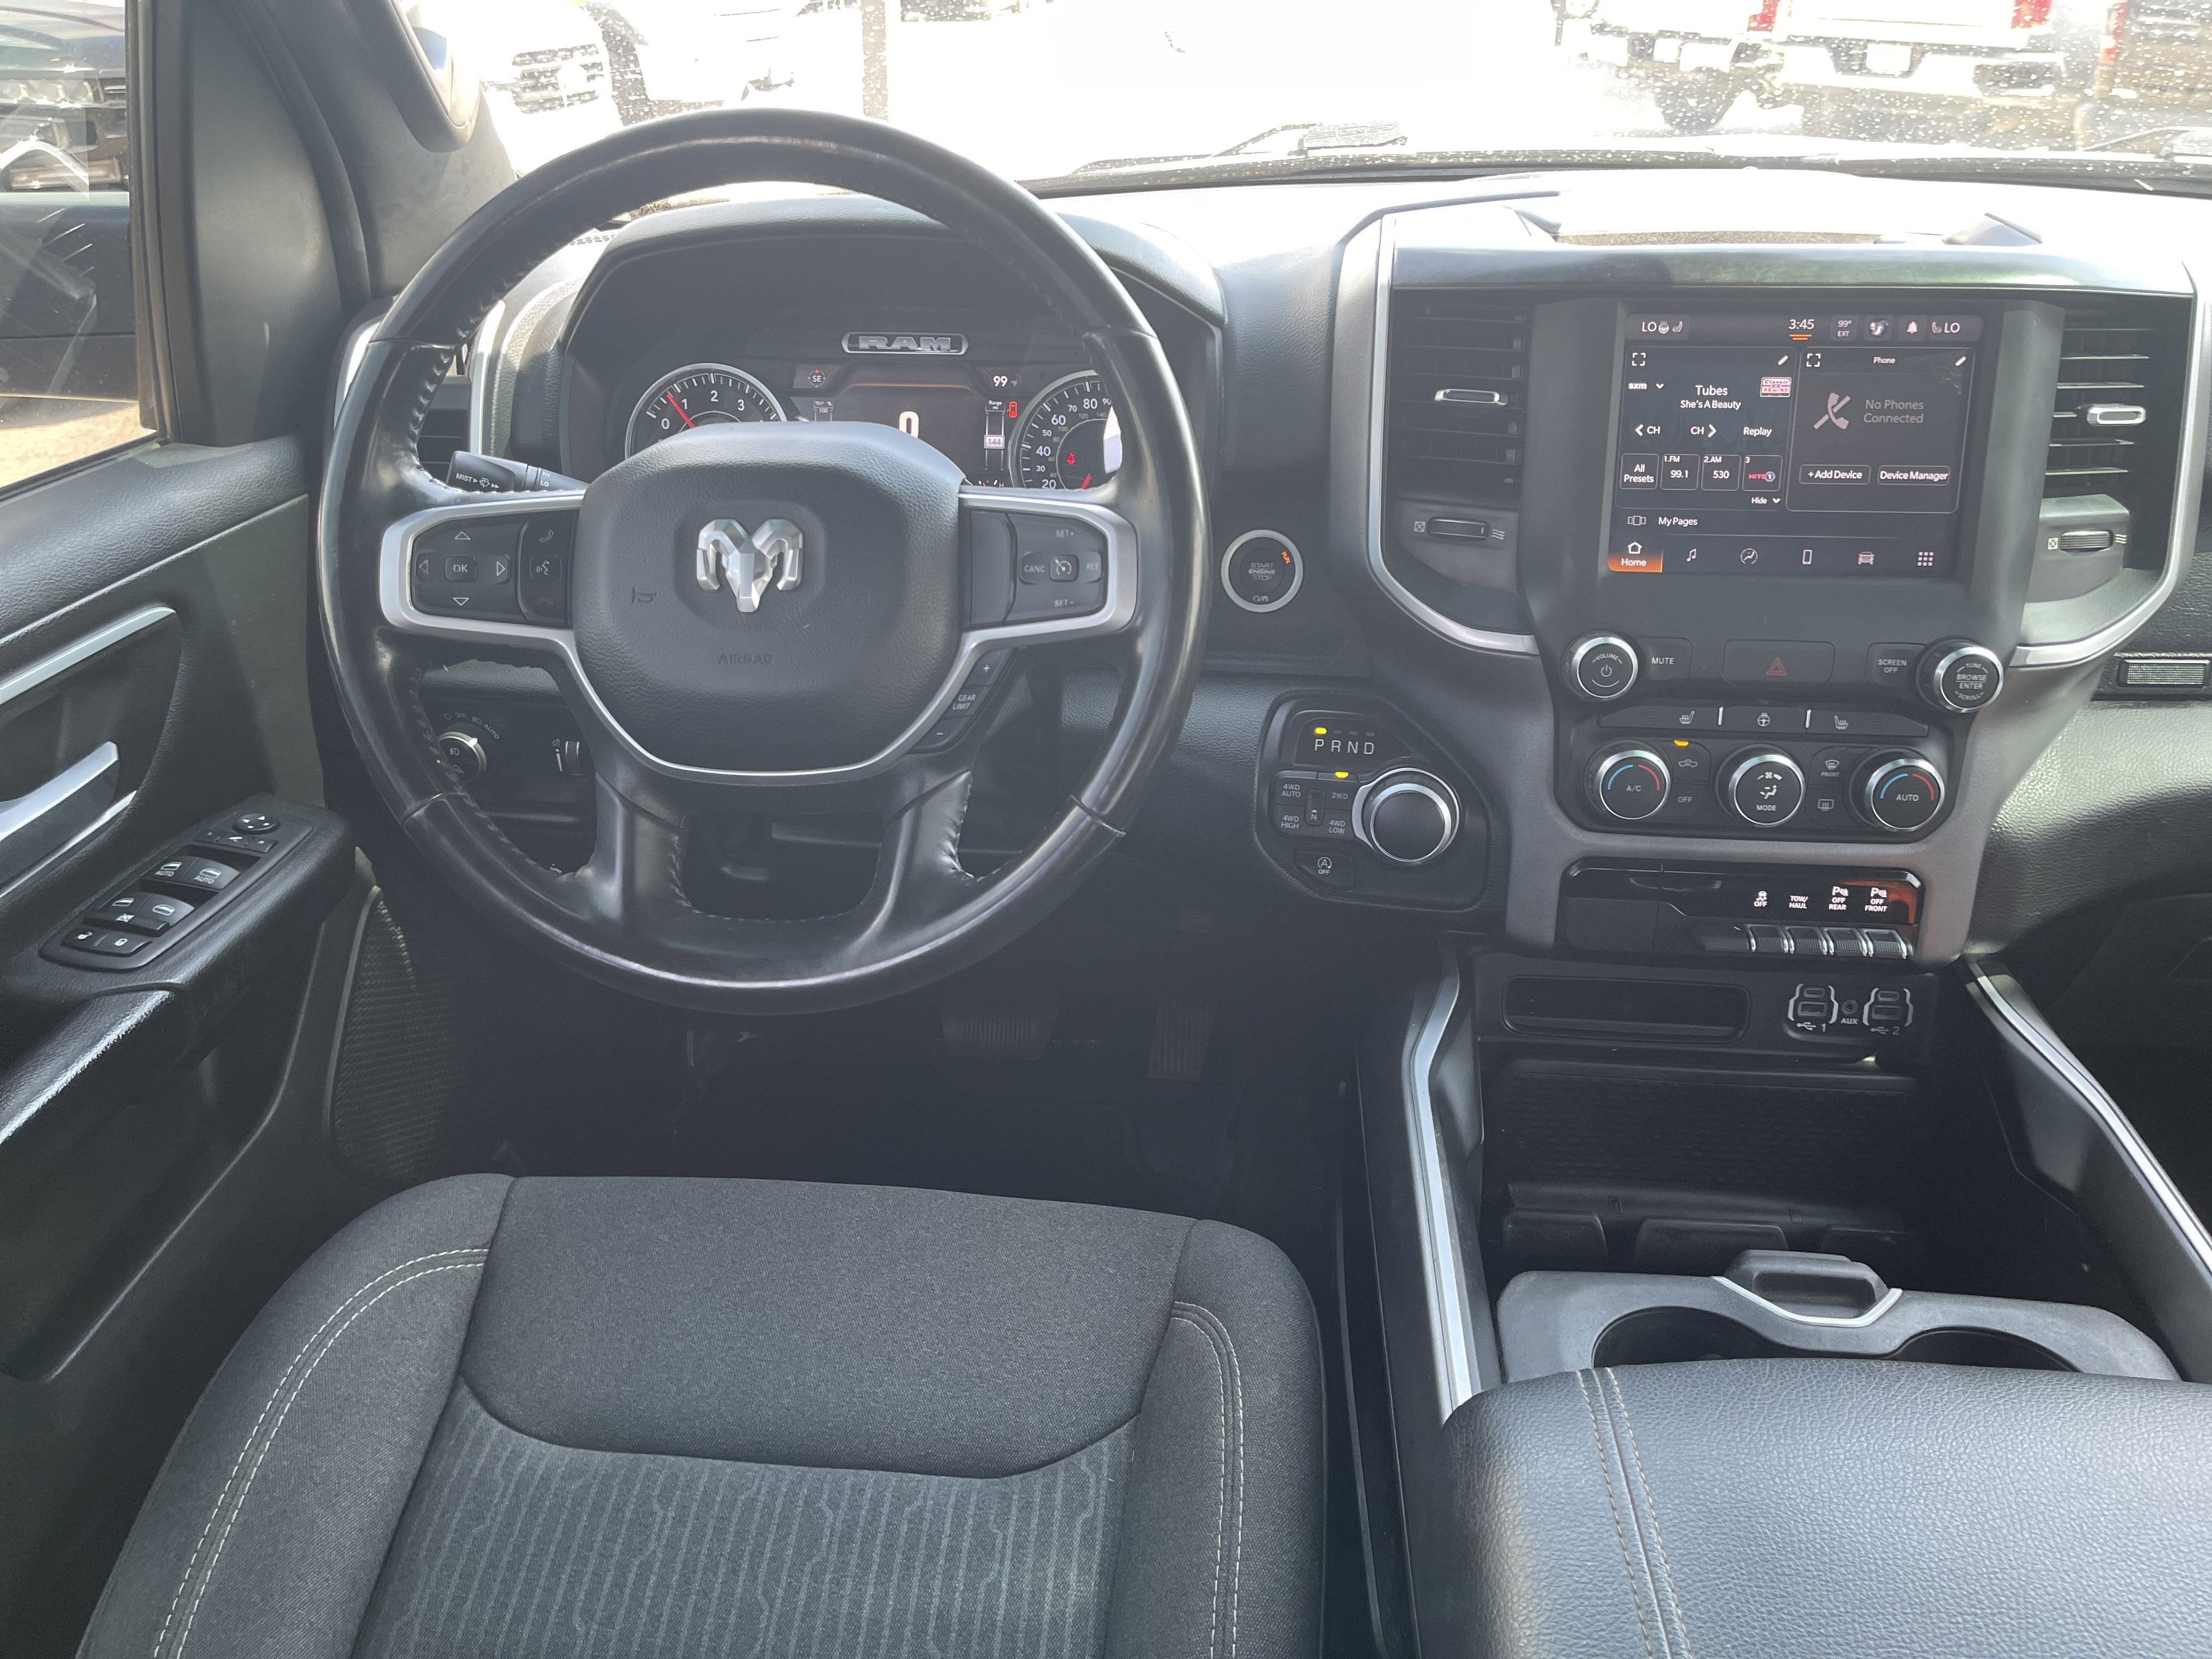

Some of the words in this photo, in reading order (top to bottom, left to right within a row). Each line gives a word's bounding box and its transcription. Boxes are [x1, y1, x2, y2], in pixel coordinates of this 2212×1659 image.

[1641, 321, 1657, 332] LO
[1788, 319, 1815, 330] 3:45
[1944, 322, 1960, 333] LO
[859, 336, 951, 351] RAM
[993, 375, 1008, 387] 99
[1695, 385, 1728, 396] Tubes
[710, 390, 718, 402] 2
[681, 398, 687, 410] 1
[737, 399, 745, 411] 3
[1083, 398, 1098, 409] 80
[1680, 400, 1703, 409] She's
[1712, 400, 1741, 410] Beauty
[1865, 399, 1881, 410] No
[1884, 399, 1924, 410] Phones
[1051, 414, 1066, 425] 60
[1864, 413, 1924, 424] Connected
[661, 418, 670, 430] 0
[1646, 426, 1661, 435] CH
[1690, 426, 1704, 435] CH
[1743, 427, 1773, 437] Replay
[1036, 446, 1051, 456] 40
[1634, 464, 1645, 472] All
[455, 473, 473, 483] MIST
[1624, 474, 1654, 483] Presets
[1670, 470, 1688, 478] 99.1
[1712, 470, 1729, 479] 530
[1833, 470, 1863, 479] Device
[1880, 471, 1908, 479] Device
[1909, 471, 1949, 482] Manager
[1042, 479, 1057, 489] 20
[1658, 517, 1672, 527] My
[1673, 517, 1698, 527] Pages
[1086, 562, 1099, 571] RES
[1621, 558, 1646, 566] Home
[453, 564, 468, 573] OK
[1024, 565, 1045, 573] CANC
[718, 653, 774, 665] AIRBAG
[1595, 653, 1619, 661] VOLUME
[1651, 657, 1674, 665] MUTE
[484, 724, 499, 739] AUTO
[194, 875, 215, 884] AUTO
[1821, 1023, 1826, 1032] 1
[1893, 1026, 1900, 1035] 2
